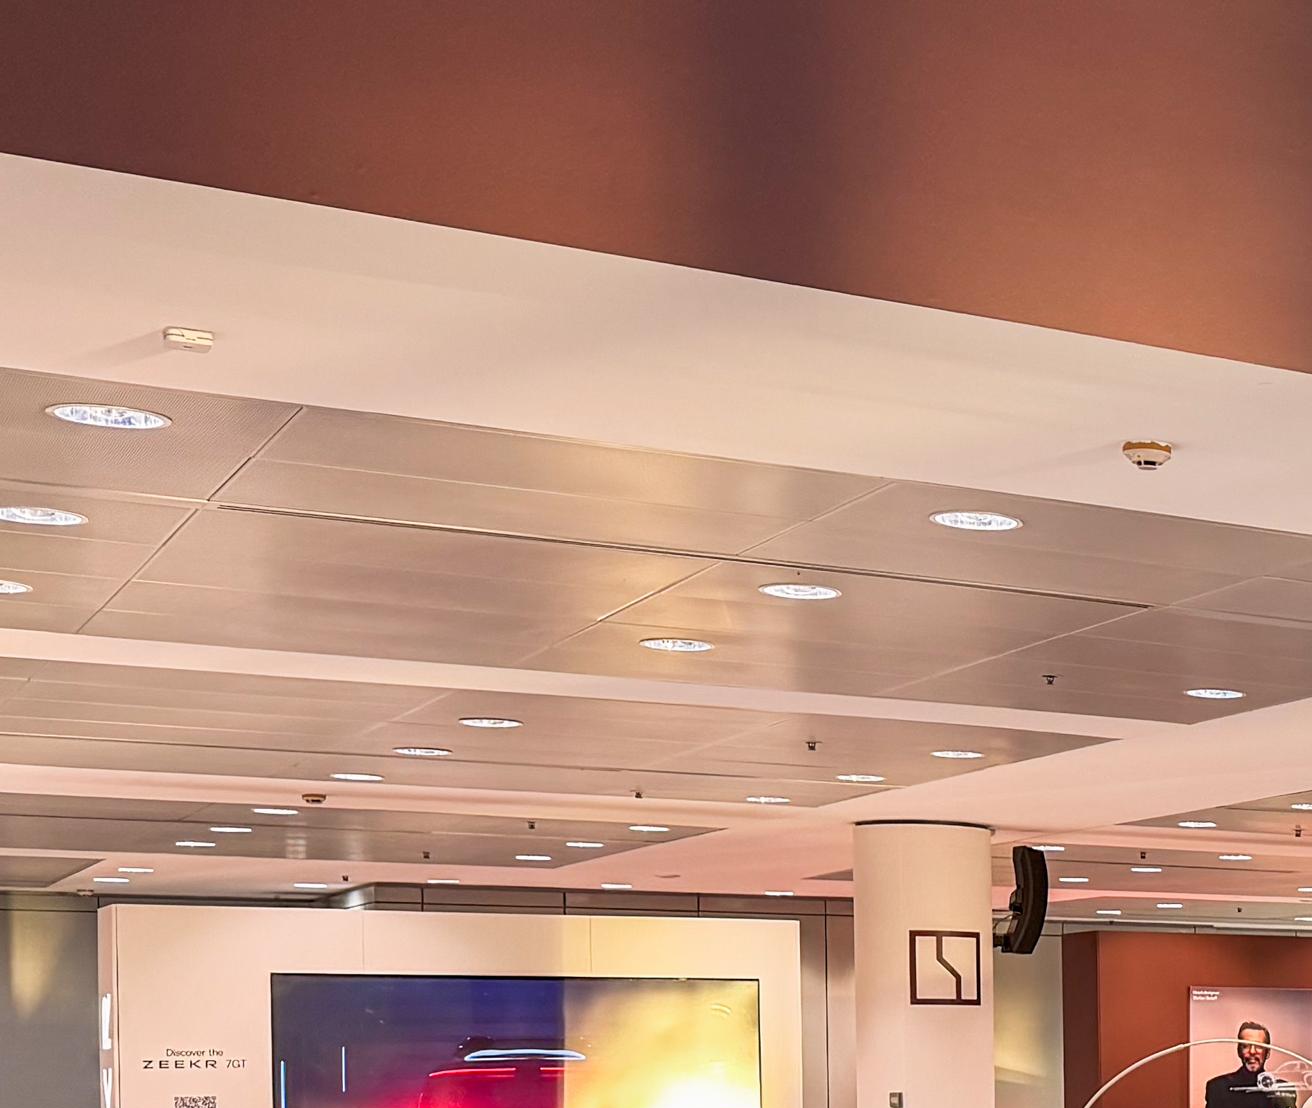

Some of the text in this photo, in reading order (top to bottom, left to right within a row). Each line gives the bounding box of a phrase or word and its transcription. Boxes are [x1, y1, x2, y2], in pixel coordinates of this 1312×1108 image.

[166, 1048, 224, 1057] Discover the
[143, 1059, 248, 1069] ZEEKR 7GT
